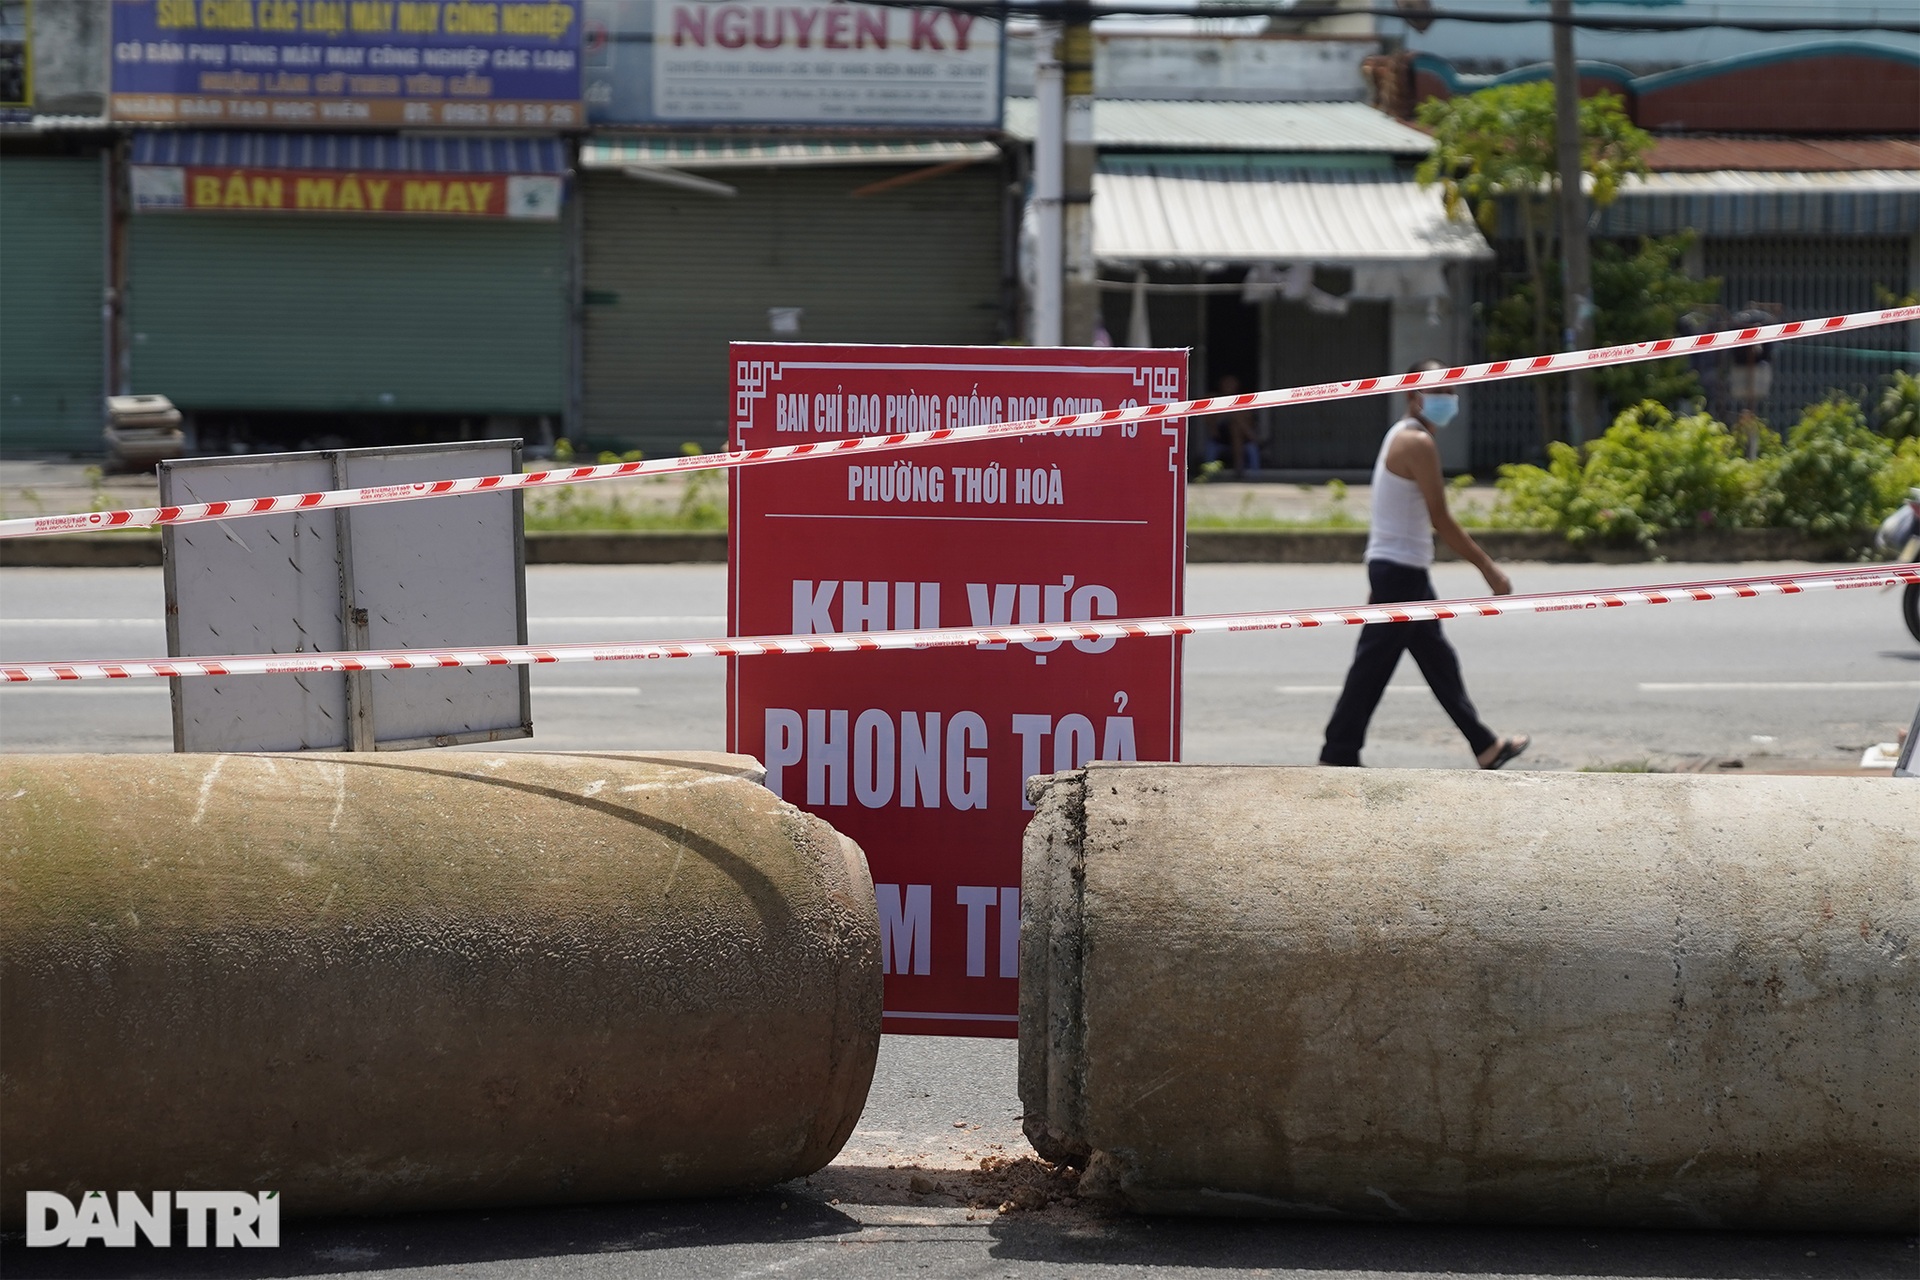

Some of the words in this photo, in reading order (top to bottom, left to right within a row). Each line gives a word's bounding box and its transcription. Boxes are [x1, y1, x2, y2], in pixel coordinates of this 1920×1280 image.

[193, 170, 283, 208] BÁN
[297, 174, 390, 211] MÁY
[404, 180, 493, 213] MAY
[776, 393, 809, 432] BAN
[814, 384, 843, 433] CHỈ
[847, 394, 881, 438] ĐẠO
[885, 388, 941, 433] PHÒNG
[946, 383, 1003, 430] CHỐNG
[1007, 396, 1048, 443] DỊCH
[1053, 397, 1103, 437] COVID
[848, 459, 944, 503] PHƯỜNG
[952, 461, 1007, 504] THỚI
[1015, 463, 1064, 505] HOÀ
[792, 579, 941, 650] KHU
[965, 575, 1118, 665] VỰC
[765, 707, 989, 811] PHONG
